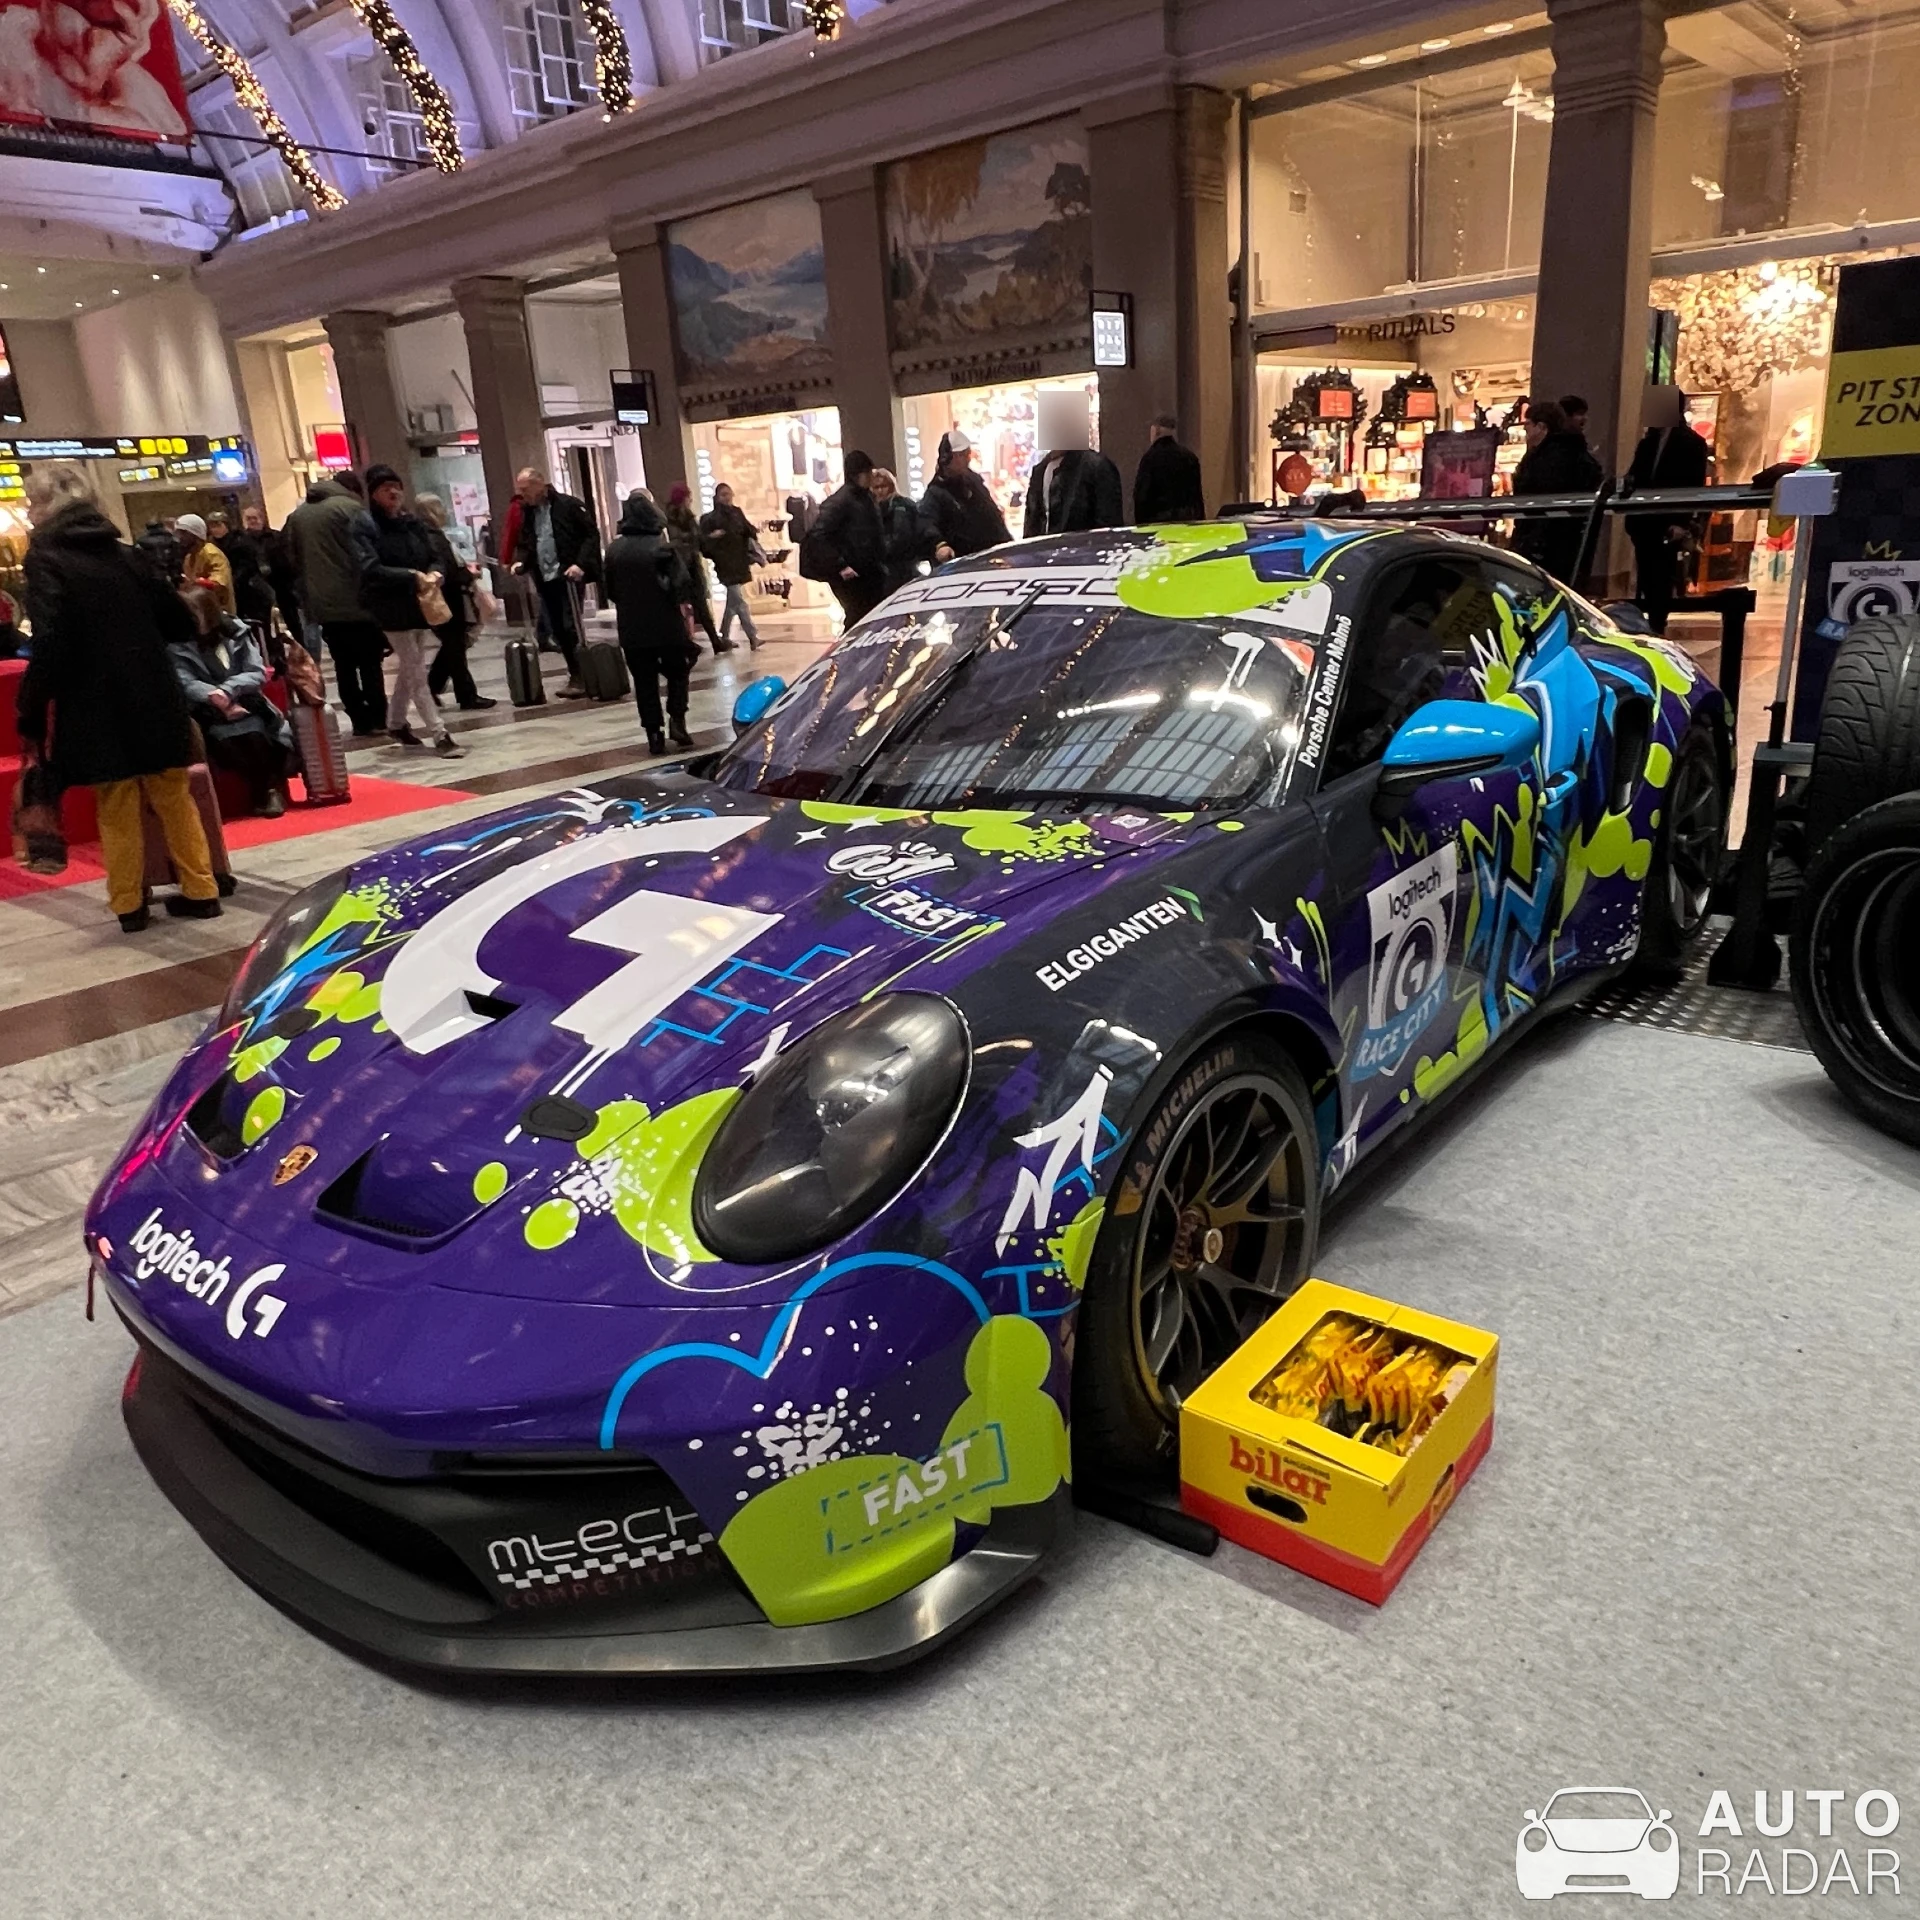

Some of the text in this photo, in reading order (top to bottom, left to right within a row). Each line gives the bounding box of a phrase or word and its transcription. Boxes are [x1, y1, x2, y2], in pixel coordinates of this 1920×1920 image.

[1368, 314, 1456, 343] RITUALS
[1837, 379, 1885, 404] PIT
[1847, 564, 1906, 581] logitech
[1822, 622, 1847, 641] RA
[1298, 613, 1353, 769] Porsche Center Malmö
[876, 889, 978, 932] FAST
[1388, 866, 1442, 921] logitech
[1034, 895, 1188, 994] ELGIGANTEN
[1394, 941, 1427, 1011] G
[1355, 978, 1445, 1068] RACE CITY
[1146, 1046, 1236, 1157] MICHELIN
[128, 1207, 288, 1340] logitech G
[863, 1438, 974, 1527] FAST
[1229, 1434, 1332, 1505] bilar
[502, 1554, 722, 1609] COMPETITION
